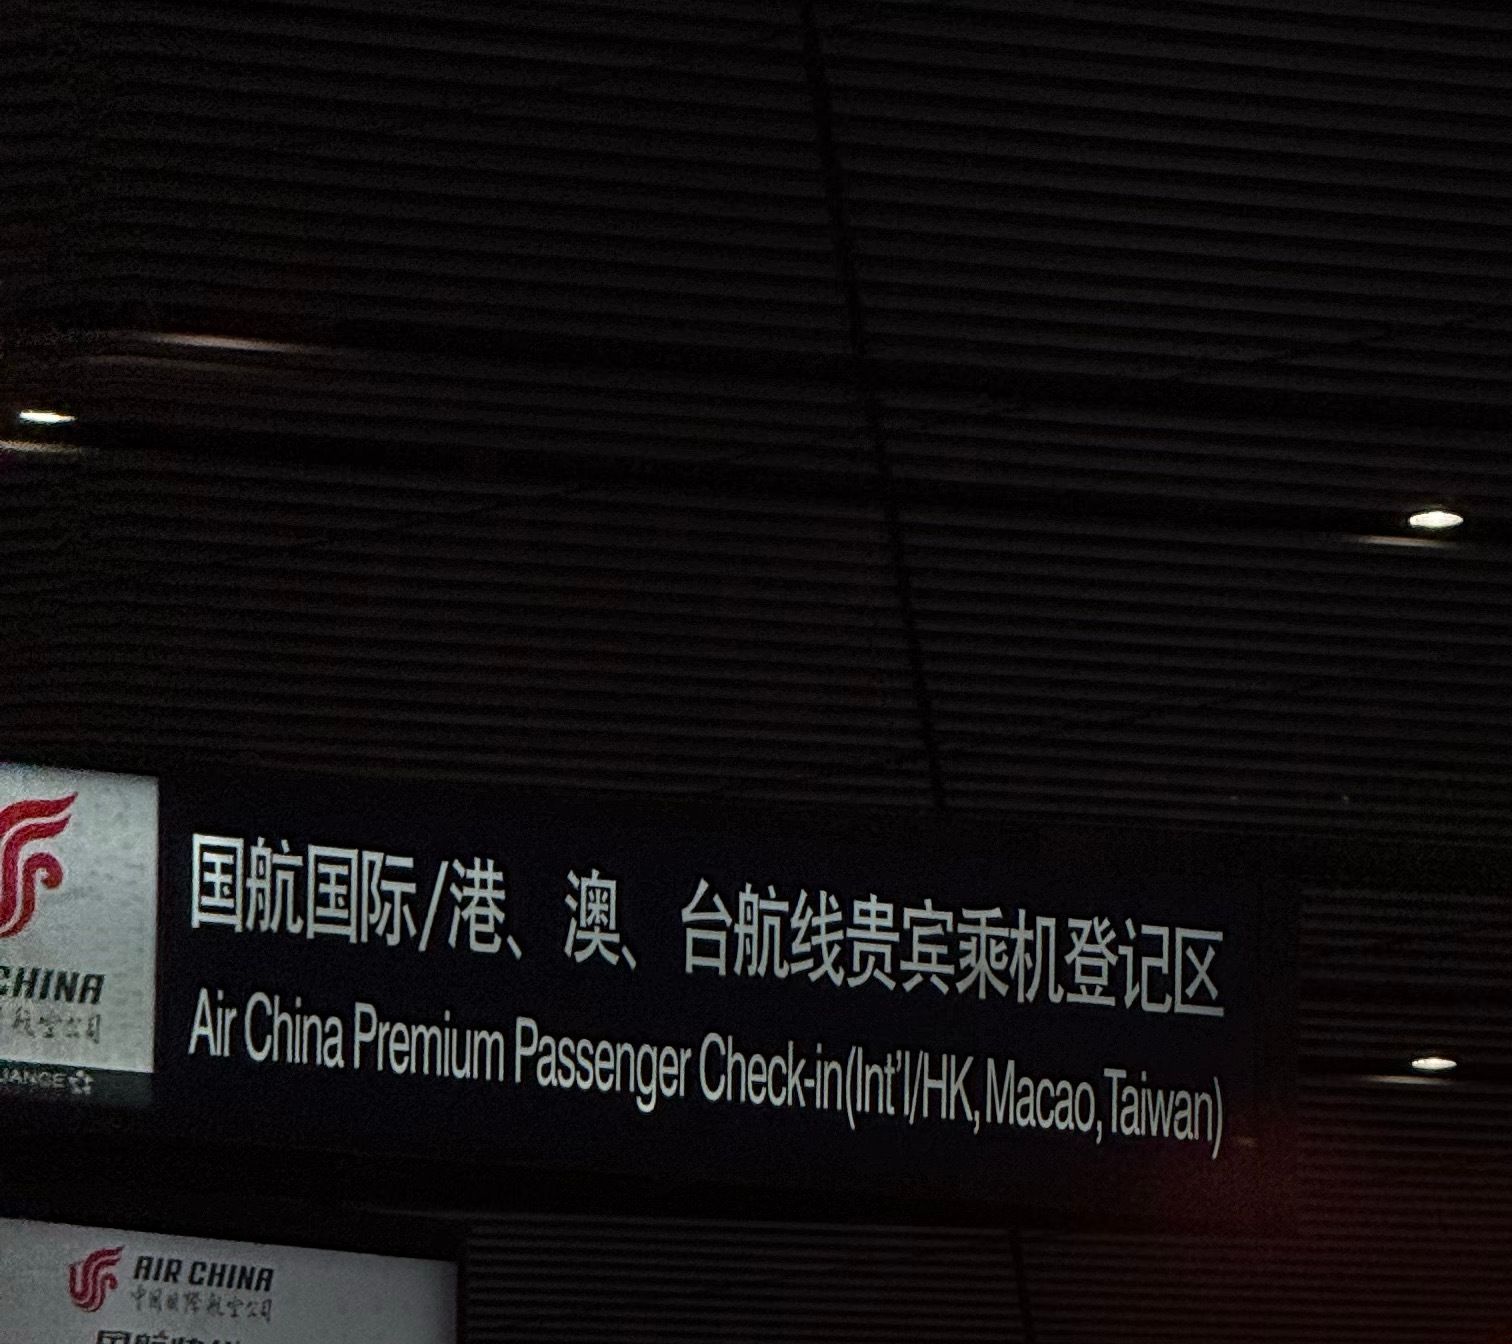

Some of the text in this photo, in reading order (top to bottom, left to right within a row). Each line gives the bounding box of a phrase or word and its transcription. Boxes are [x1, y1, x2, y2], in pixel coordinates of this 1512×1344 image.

[188, 987, 237, 1058] Air
[244, 991, 345, 1068] China
[354, 1002, 504, 1081] Premium
[515, 1016, 693, 1114] Passenger
[133, 1255, 275, 1292] AIR CHINA
